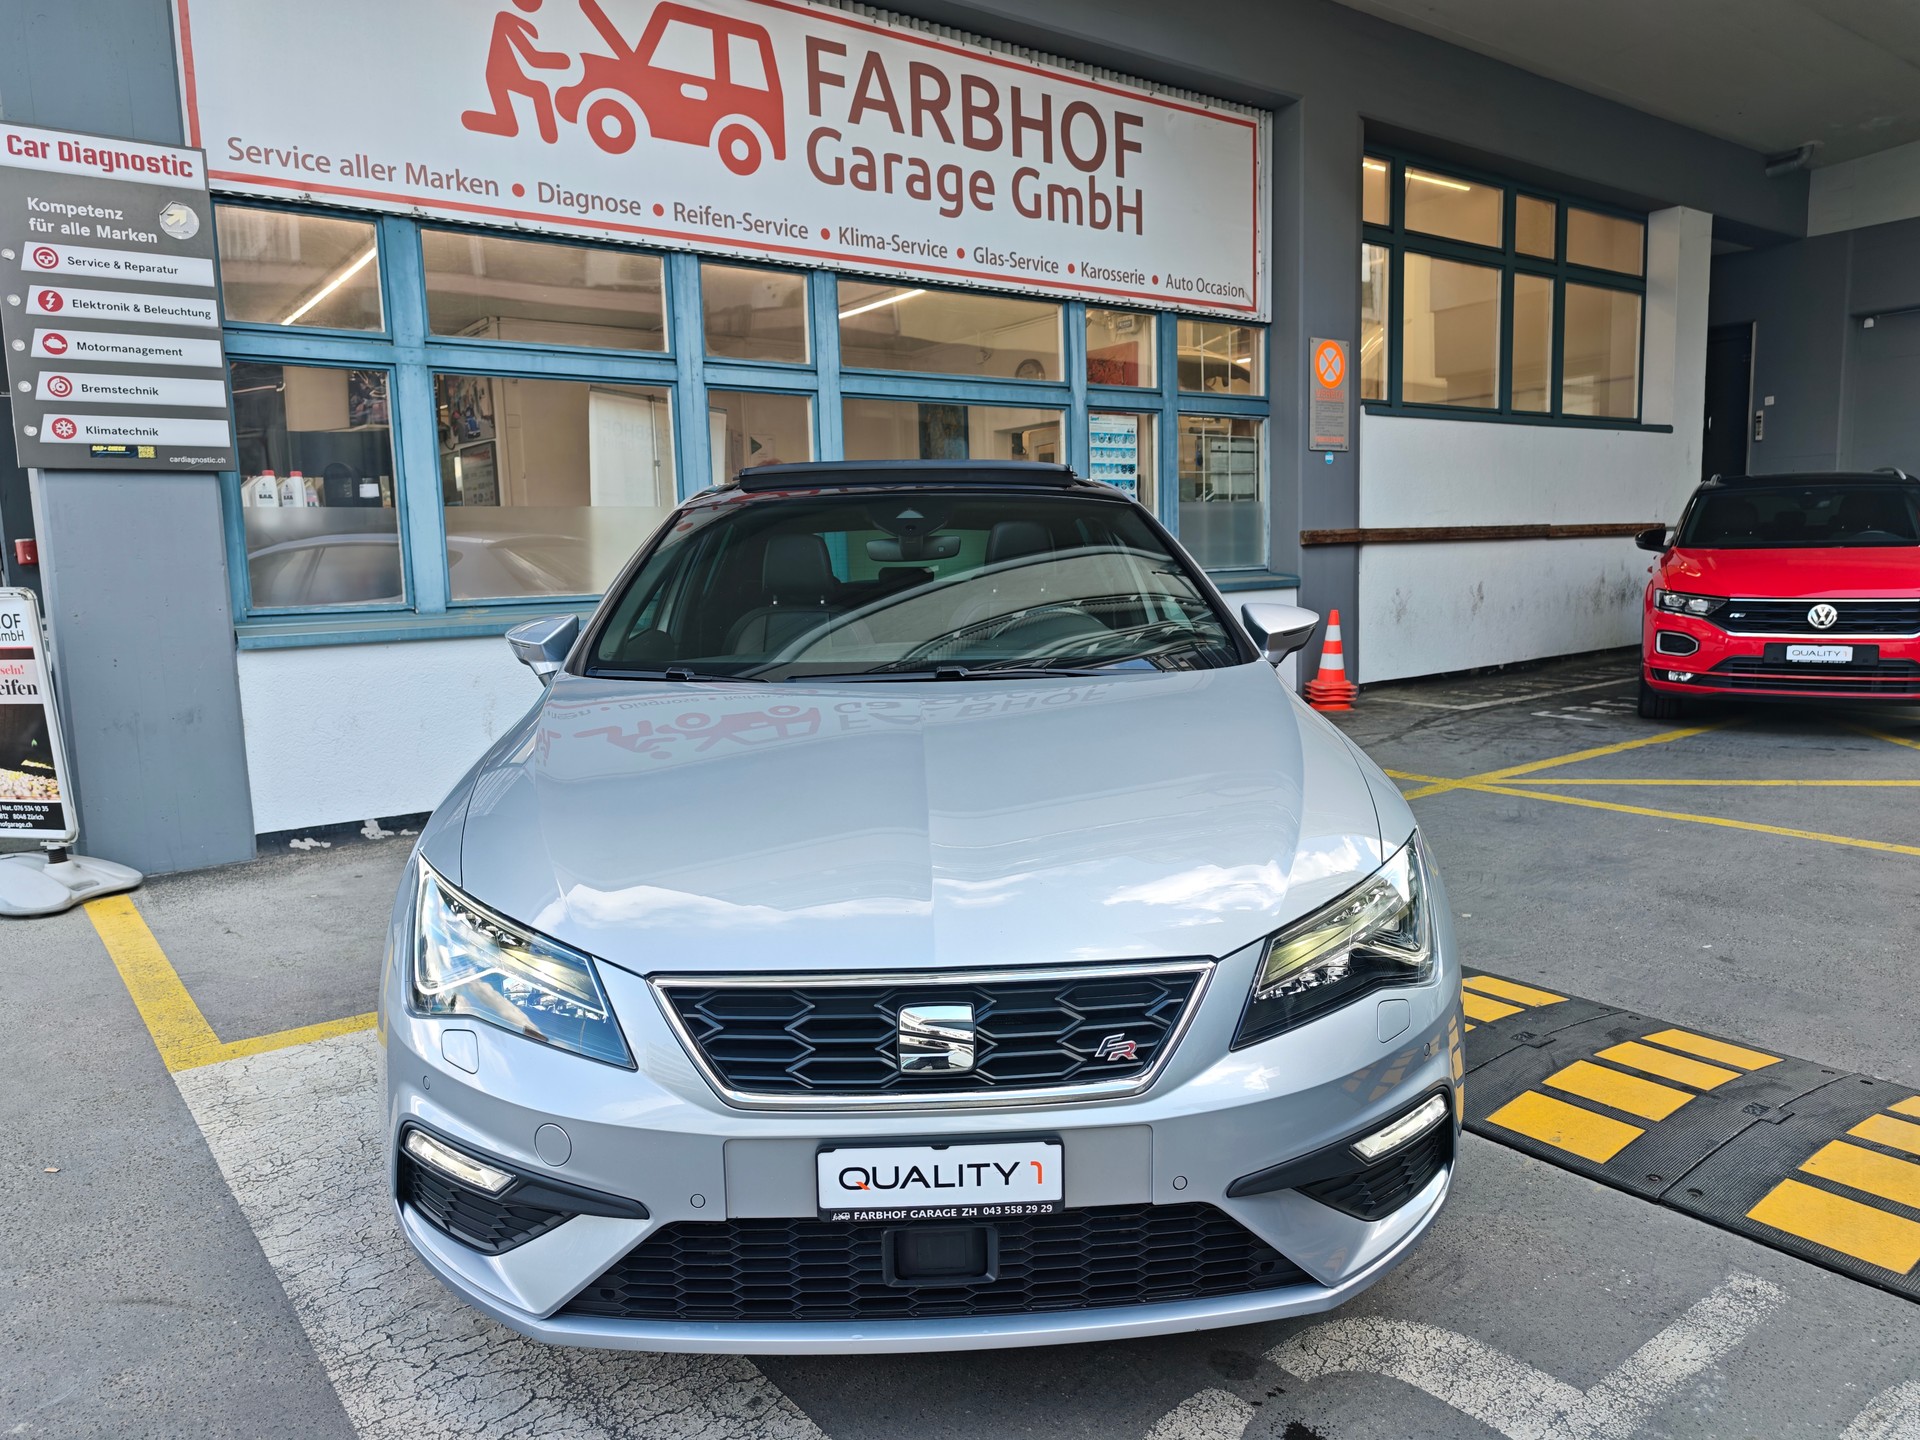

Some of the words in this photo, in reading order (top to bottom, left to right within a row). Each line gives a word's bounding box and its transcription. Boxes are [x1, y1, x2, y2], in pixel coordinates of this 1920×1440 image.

[805, 35, 1144, 179] FARBHOF
[6, 133, 50, 160] Car
[57, 140, 194, 179] Diagnostic
[807, 126, 996, 219] Garage
[1012, 167, 1143, 236] GmbH
[27, 196, 124, 222] Kompetenz
[227, 136, 331, 174] Service
[339, 153, 400, 183] aller
[405, 161, 499, 197] Marken
[537, 181, 642, 218] Diagnose
[673, 201, 809, 240] Reifen-Service
[838, 226, 948, 260] Klima-Service
[973, 246, 1060, 275] Glas-Service
[1080, 261, 1146, 286] Karosserie
[1165, 273, 1195, 292] Auto
[1196, 277, 1246, 299] Occasion
[28, 217, 55, 234] für
[60, 221, 91, 237] alle
[96, 225, 158, 244] Marken
[67, 255, 111, 270] Service
[113, 259, 121, 269] &
[124, 261, 179, 277] Reparatur
[72, 298, 131, 313] Elektronik
[133, 303, 141, 313] &
[143, 303, 212, 321] Beleuchtung
[76, 341, 184, 358] Motormanagement
[81, 383, 160, 397] Bremstechnik
[85, 424, 160, 437] Klimatechnik
[169, 455, 227, 465] cardiagnostic.ch
[0, 613, 21, 630] OF
[1792, 649, 1841, 657] QUALITY
[838, 1161, 1021, 1191] QUALITY
[1030, 1160, 1043, 1185] 1
[854, 1210, 907, 1221] FARBHOF
[910, 1208, 957, 1219] GARAGE
[962, 1207, 977, 1216] ZH
[983, 1206, 1002, 1215] 043
[1004, 1205, 1023, 1214] 558
[1025, 1204, 1038, 1213] 29
[1040, 1204, 1053, 1213] 29
